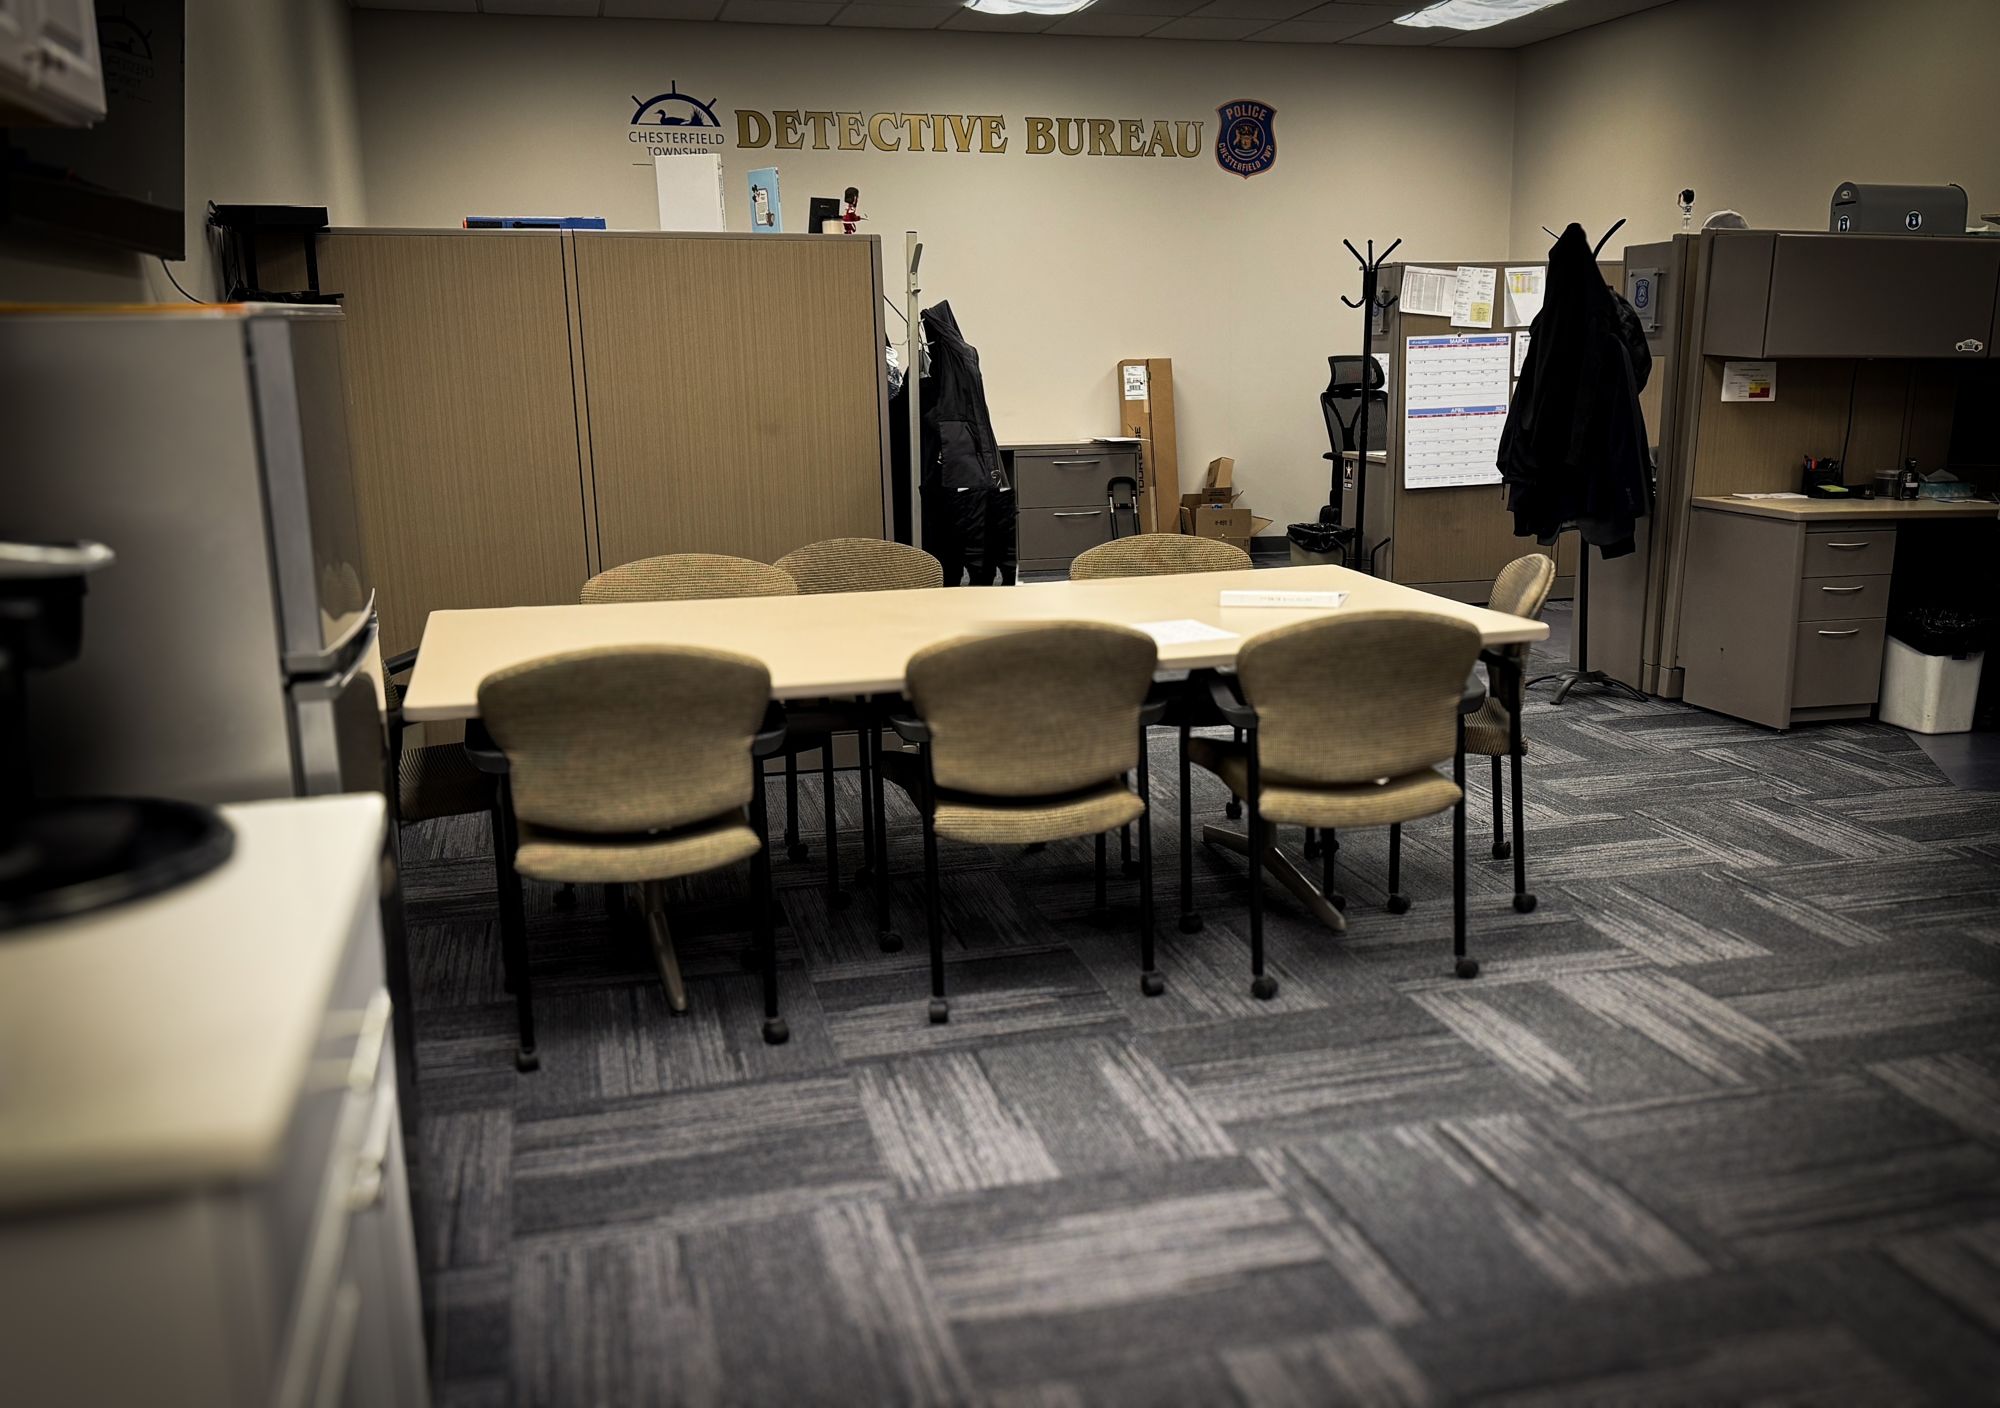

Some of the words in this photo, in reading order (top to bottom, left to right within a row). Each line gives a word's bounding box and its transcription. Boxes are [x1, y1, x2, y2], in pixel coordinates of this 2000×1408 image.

[1226, 104, 1267, 120] POLICE
[628, 131, 725, 145] CHESTERFIELD
[734, 109, 1008, 154] DETECTIVE
[1025, 116, 1204, 158] BUREAU
[646, 146, 708, 156] TOWNSHIP
[1218, 142, 1261, 172] CHESTERFIELD
